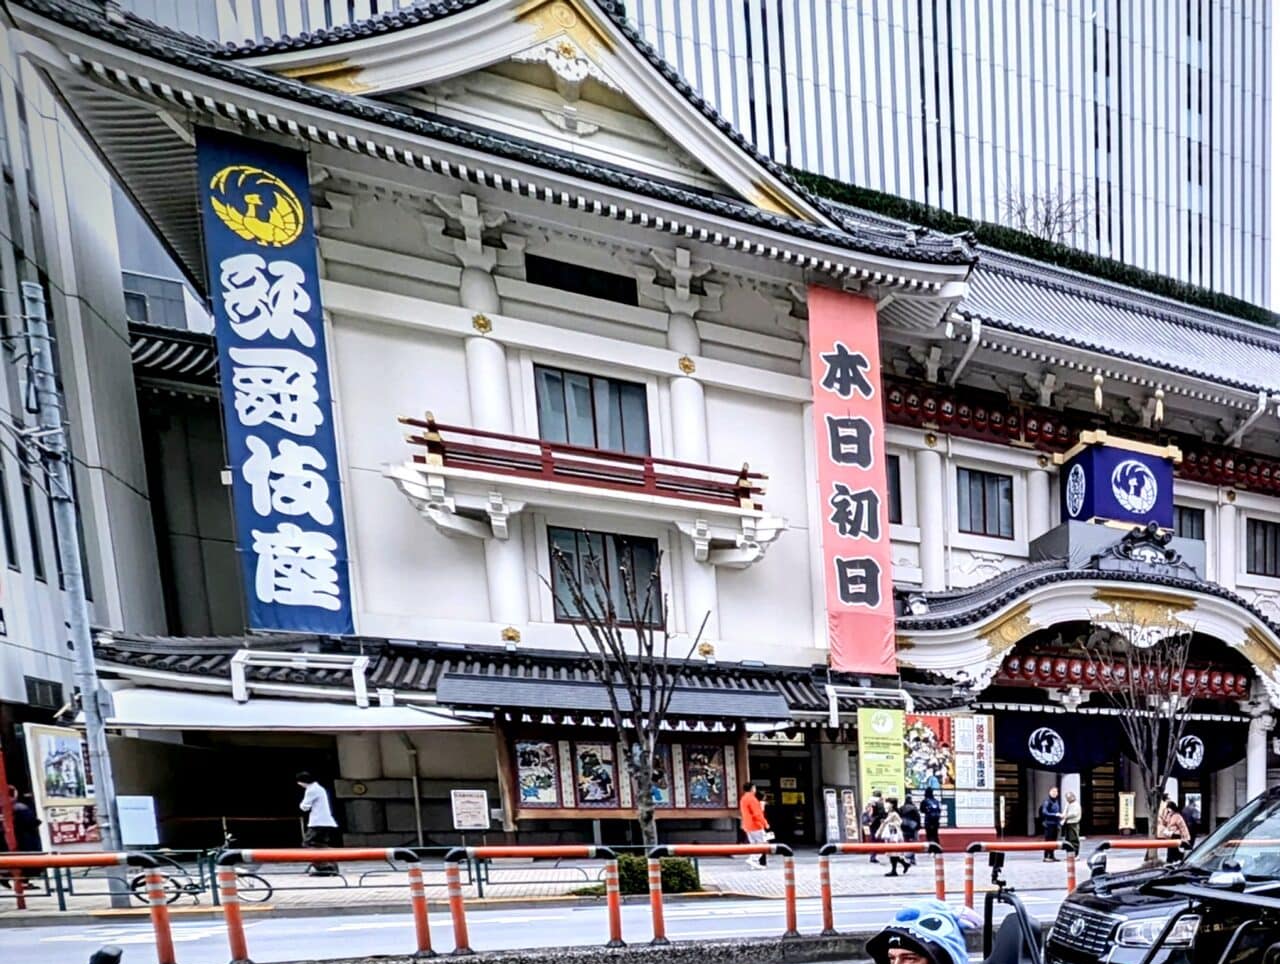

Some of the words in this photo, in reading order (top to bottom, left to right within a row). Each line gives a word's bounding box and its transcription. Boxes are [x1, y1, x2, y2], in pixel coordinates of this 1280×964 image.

[219, 252, 341, 612] 歌舞伎座
[820, 342, 881, 607] 本日初日
